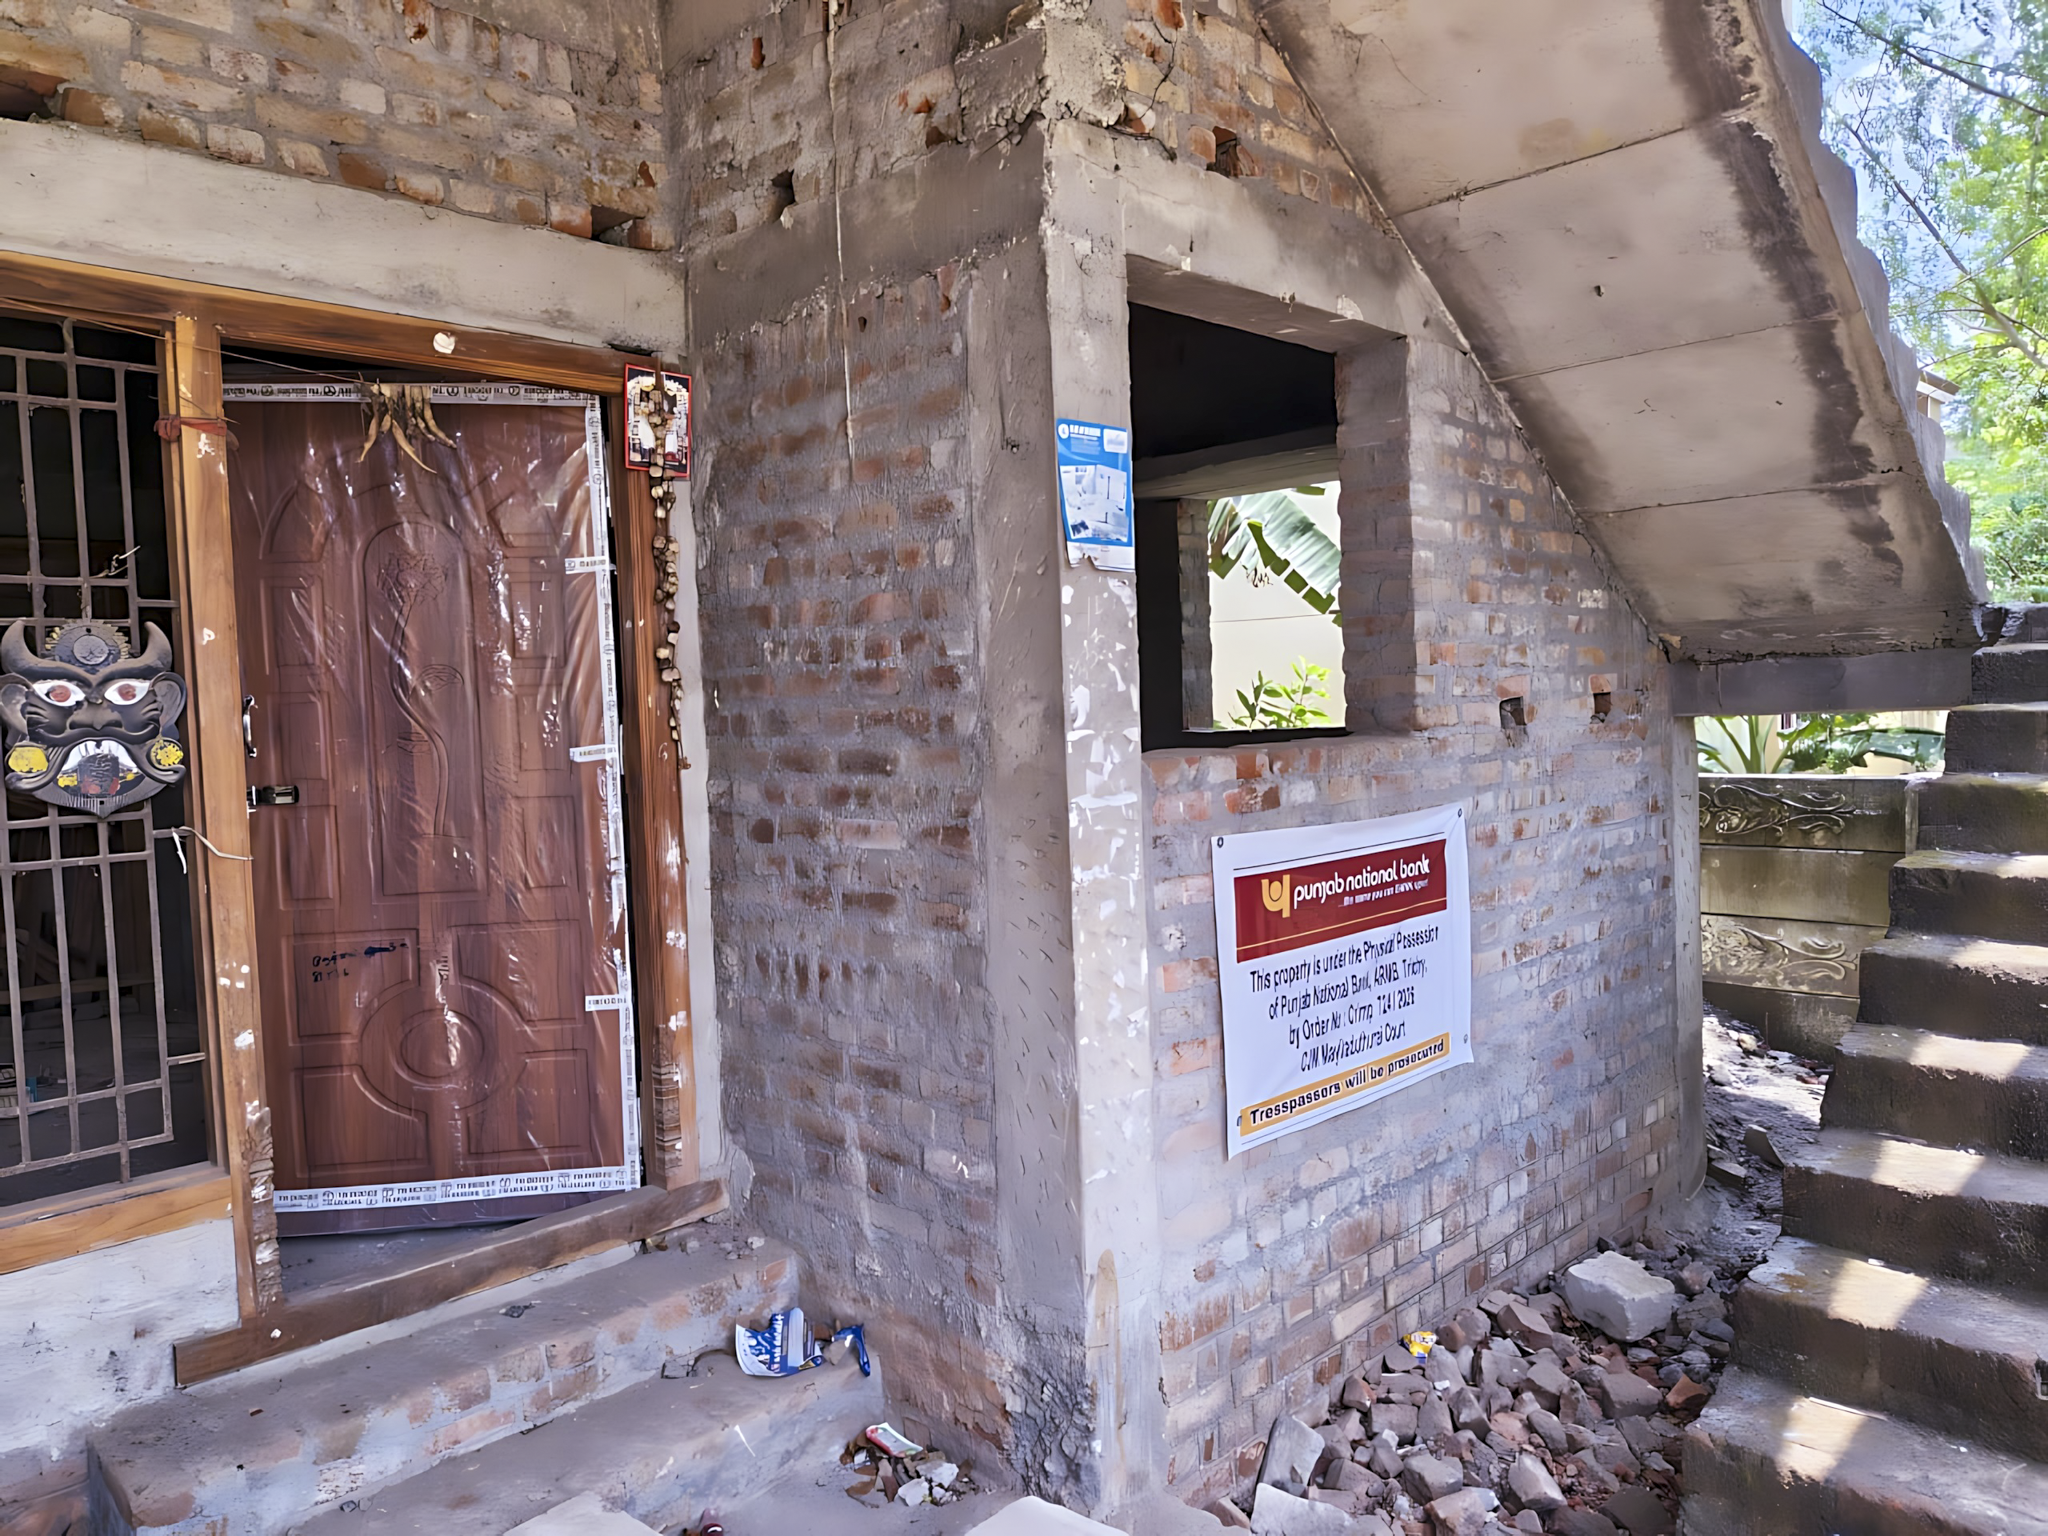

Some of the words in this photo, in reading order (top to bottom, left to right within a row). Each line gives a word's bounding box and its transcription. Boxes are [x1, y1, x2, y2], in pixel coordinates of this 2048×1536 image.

[1294, 872, 1345, 910] punjab
[1345, 860, 1398, 892] national
[1400, 853, 1430, 880] bank
[1250, 967, 1271, 993] This
[1273, 959, 1311, 993] property
[1313, 954, 1321, 976] is
[1323, 949, 1346, 973] under
[1348, 944, 1362, 966] the
[1268, 996, 1279, 1020] of
[1281, 988, 1311, 1018] Punjab
[1313, 976, 1349, 1006] National
[1289, 1024, 1300, 1049] by
[1302, 1016, 1330, 1040] Order
[1344, 1069, 1367, 1090] will
[1370, 1065, 1384, 1081] be
